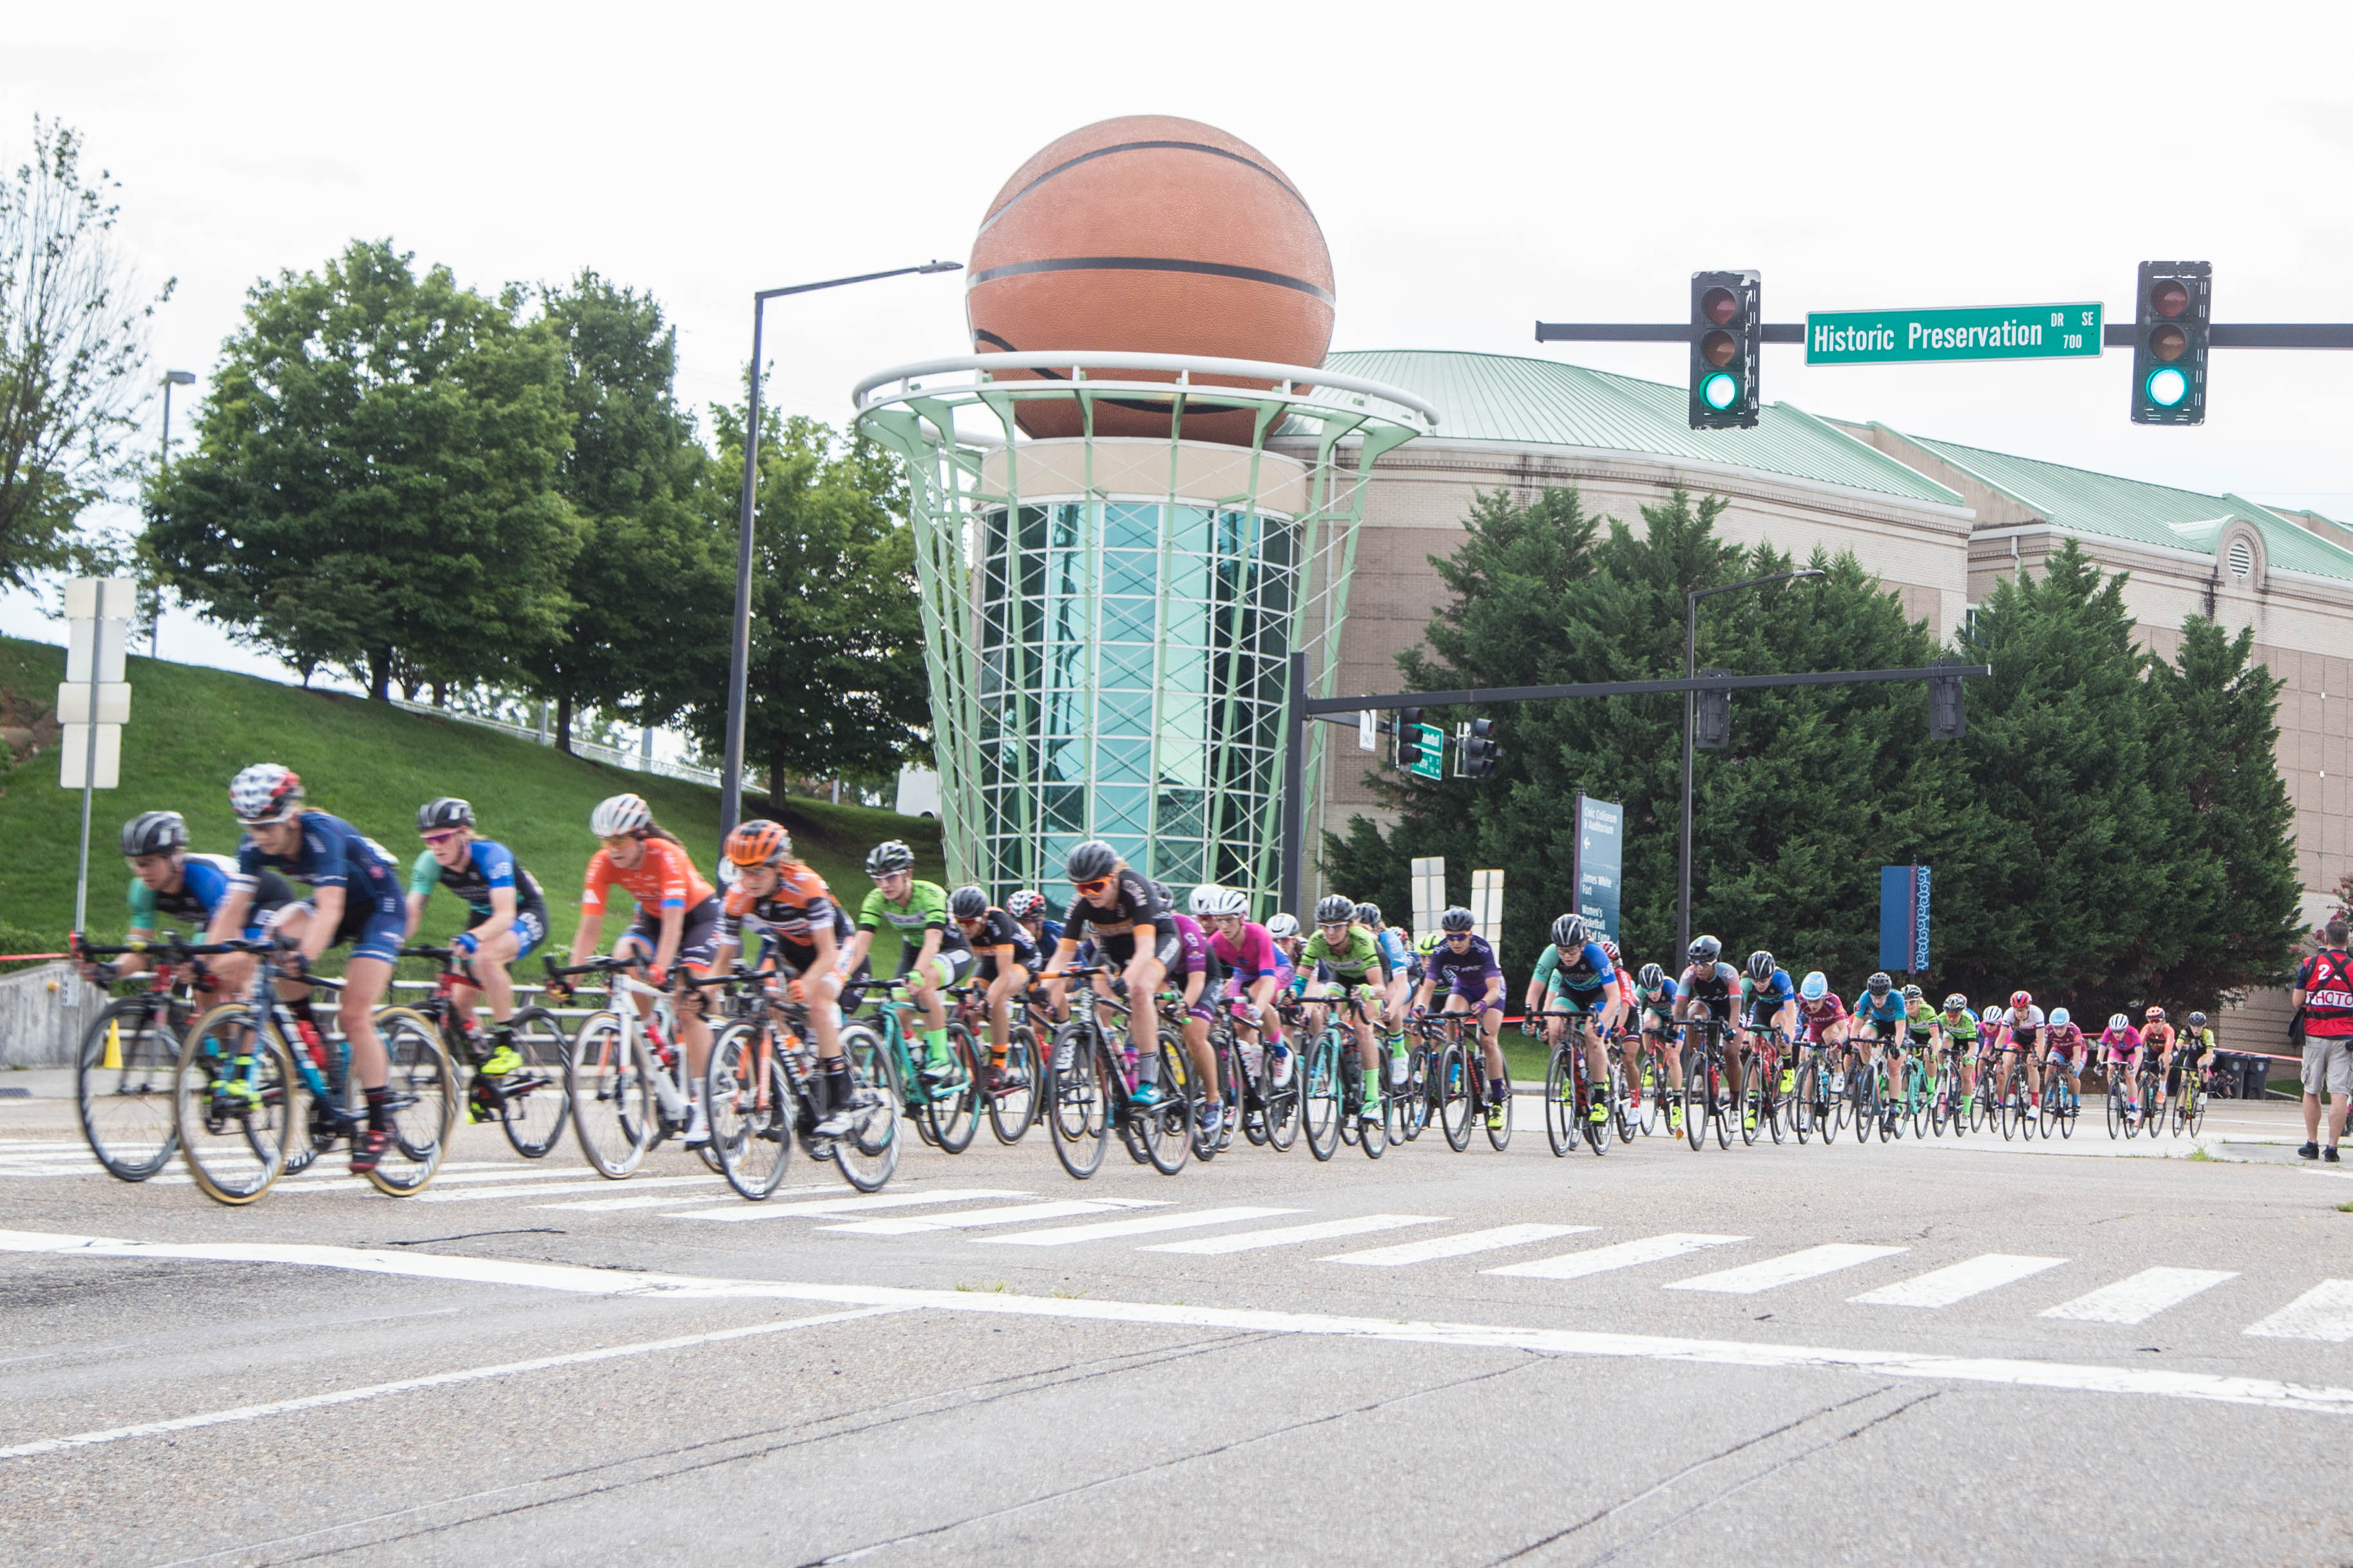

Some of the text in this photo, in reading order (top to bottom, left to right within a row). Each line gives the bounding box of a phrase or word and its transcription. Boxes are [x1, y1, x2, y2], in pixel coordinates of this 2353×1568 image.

[1815, 312, 2094, 352] Historic Preservation DR SE
[2063, 334, 2082, 349] 700
[1421, 732, 1440, 748] asketball
[1585, 806, 1618, 824] Civic Coliseum
[1588, 819, 1614, 835] Auditorium
[1583, 872, 1612, 888] James White
[1582, 884, 1592, 896] Fort
[1581, 904, 1603, 918] Women's
[1584, 916, 1605, 931] asketball
